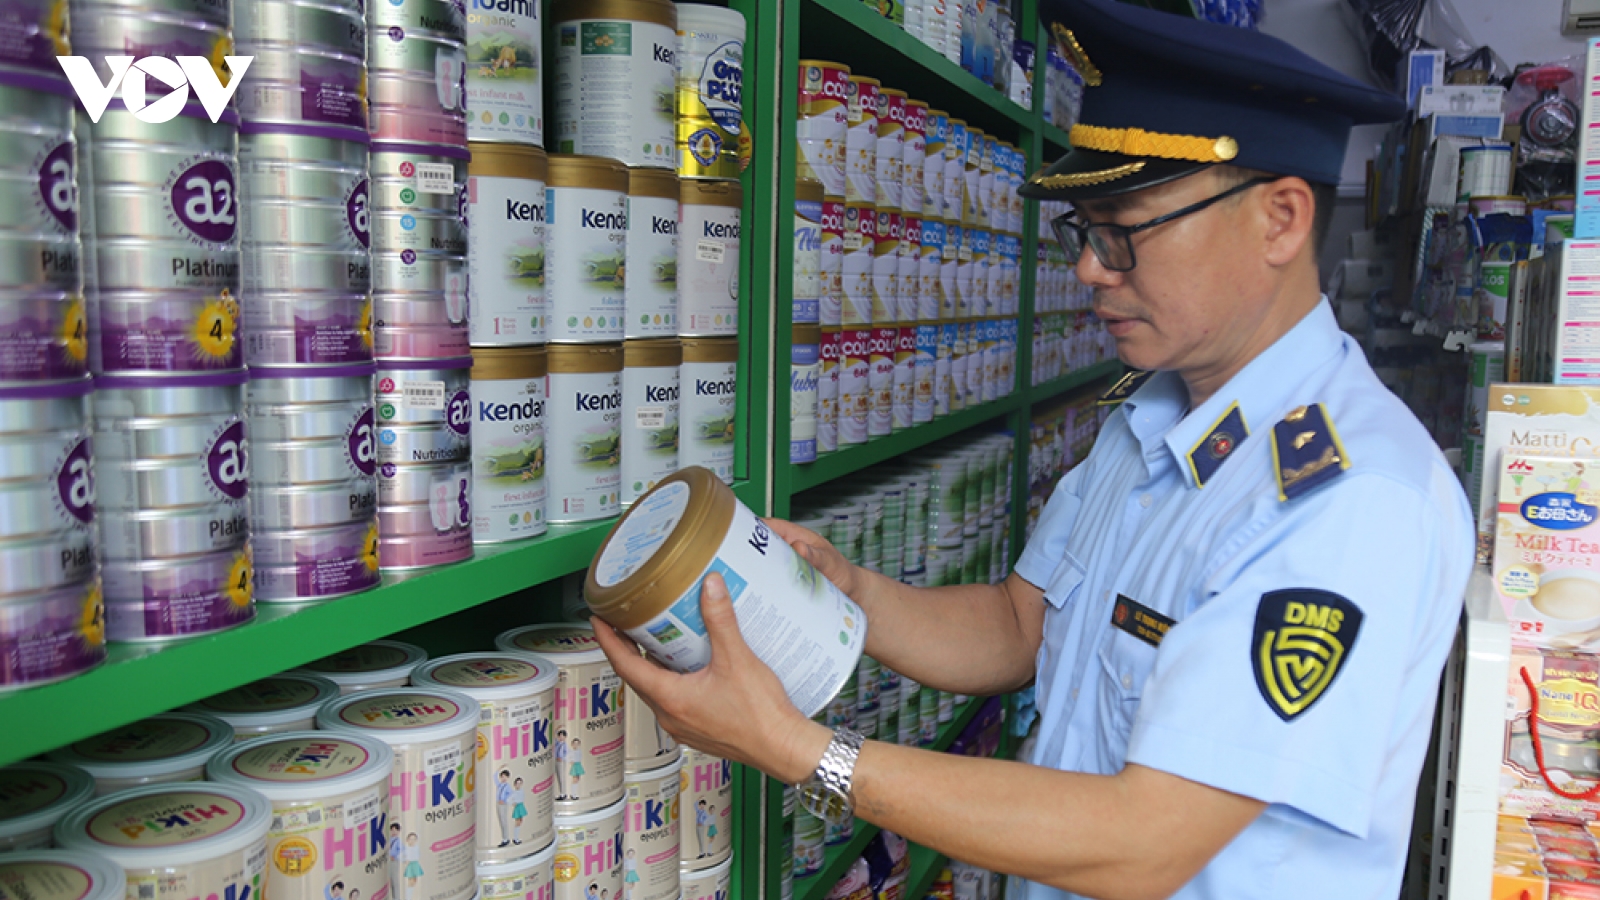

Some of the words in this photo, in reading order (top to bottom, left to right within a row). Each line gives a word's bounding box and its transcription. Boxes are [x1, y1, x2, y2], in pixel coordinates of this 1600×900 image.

[184, 175, 235, 226] a2
[210, 318, 224, 342] 4
[493, 316, 501, 335] 1
[1509, 429, 1568, 449] Matti
[1514, 532, 1562, 552] Milk
[1566, 537, 1600, 555] Tea
[1284, 601, 1345, 632] DMS
